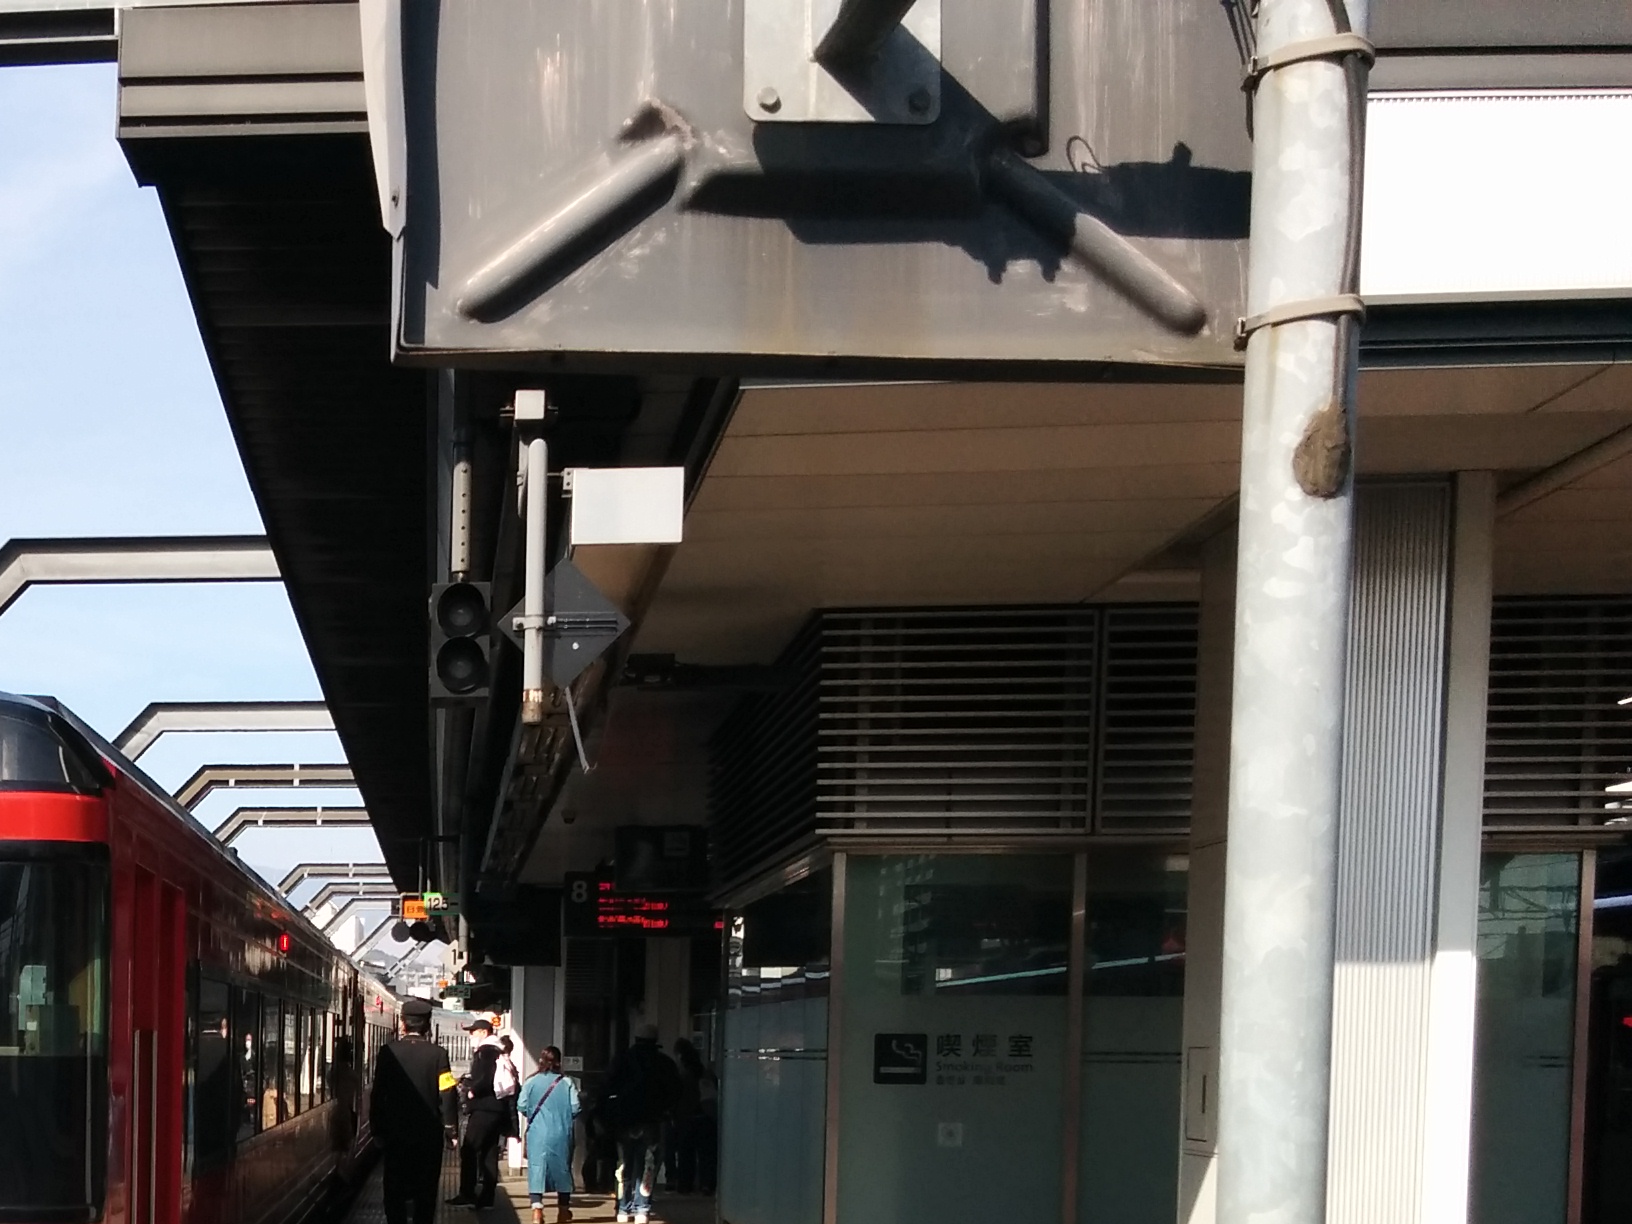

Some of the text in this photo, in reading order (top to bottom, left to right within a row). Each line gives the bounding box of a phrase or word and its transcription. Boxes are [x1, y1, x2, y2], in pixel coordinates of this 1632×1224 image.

[571, 880, 588, 903] 8
[936, 1034, 1033, 1058] 喫煙室
[996, 1061, 1033, 1073] Room
